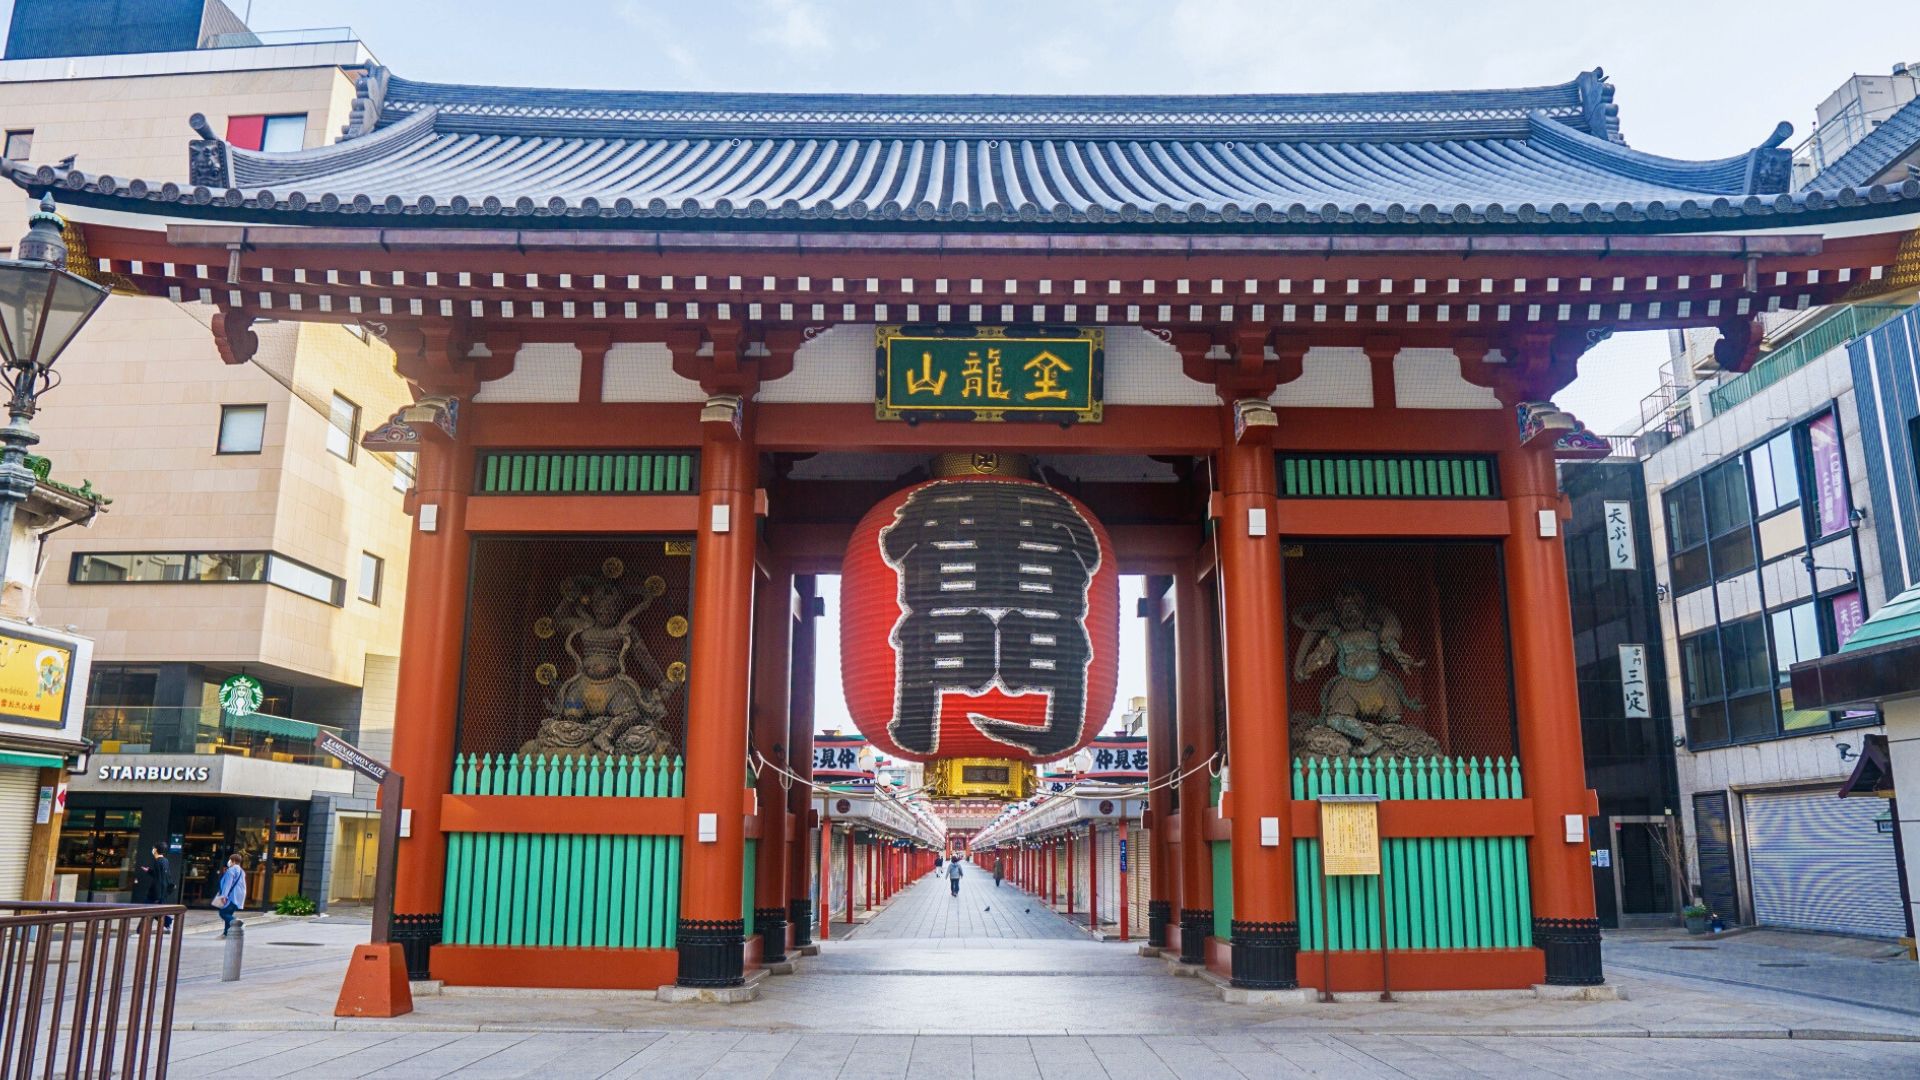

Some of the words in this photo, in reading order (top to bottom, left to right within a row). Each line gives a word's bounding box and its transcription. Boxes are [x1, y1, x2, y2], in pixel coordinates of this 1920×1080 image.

[1608, 508, 1629, 563] 天ぷら
[1624, 669, 1647, 713] 三定
[98, 765, 210, 782] STARBUCKS
[326, 739, 369, 767] KAMINARIMON
[368, 763, 387, 777] GATE
